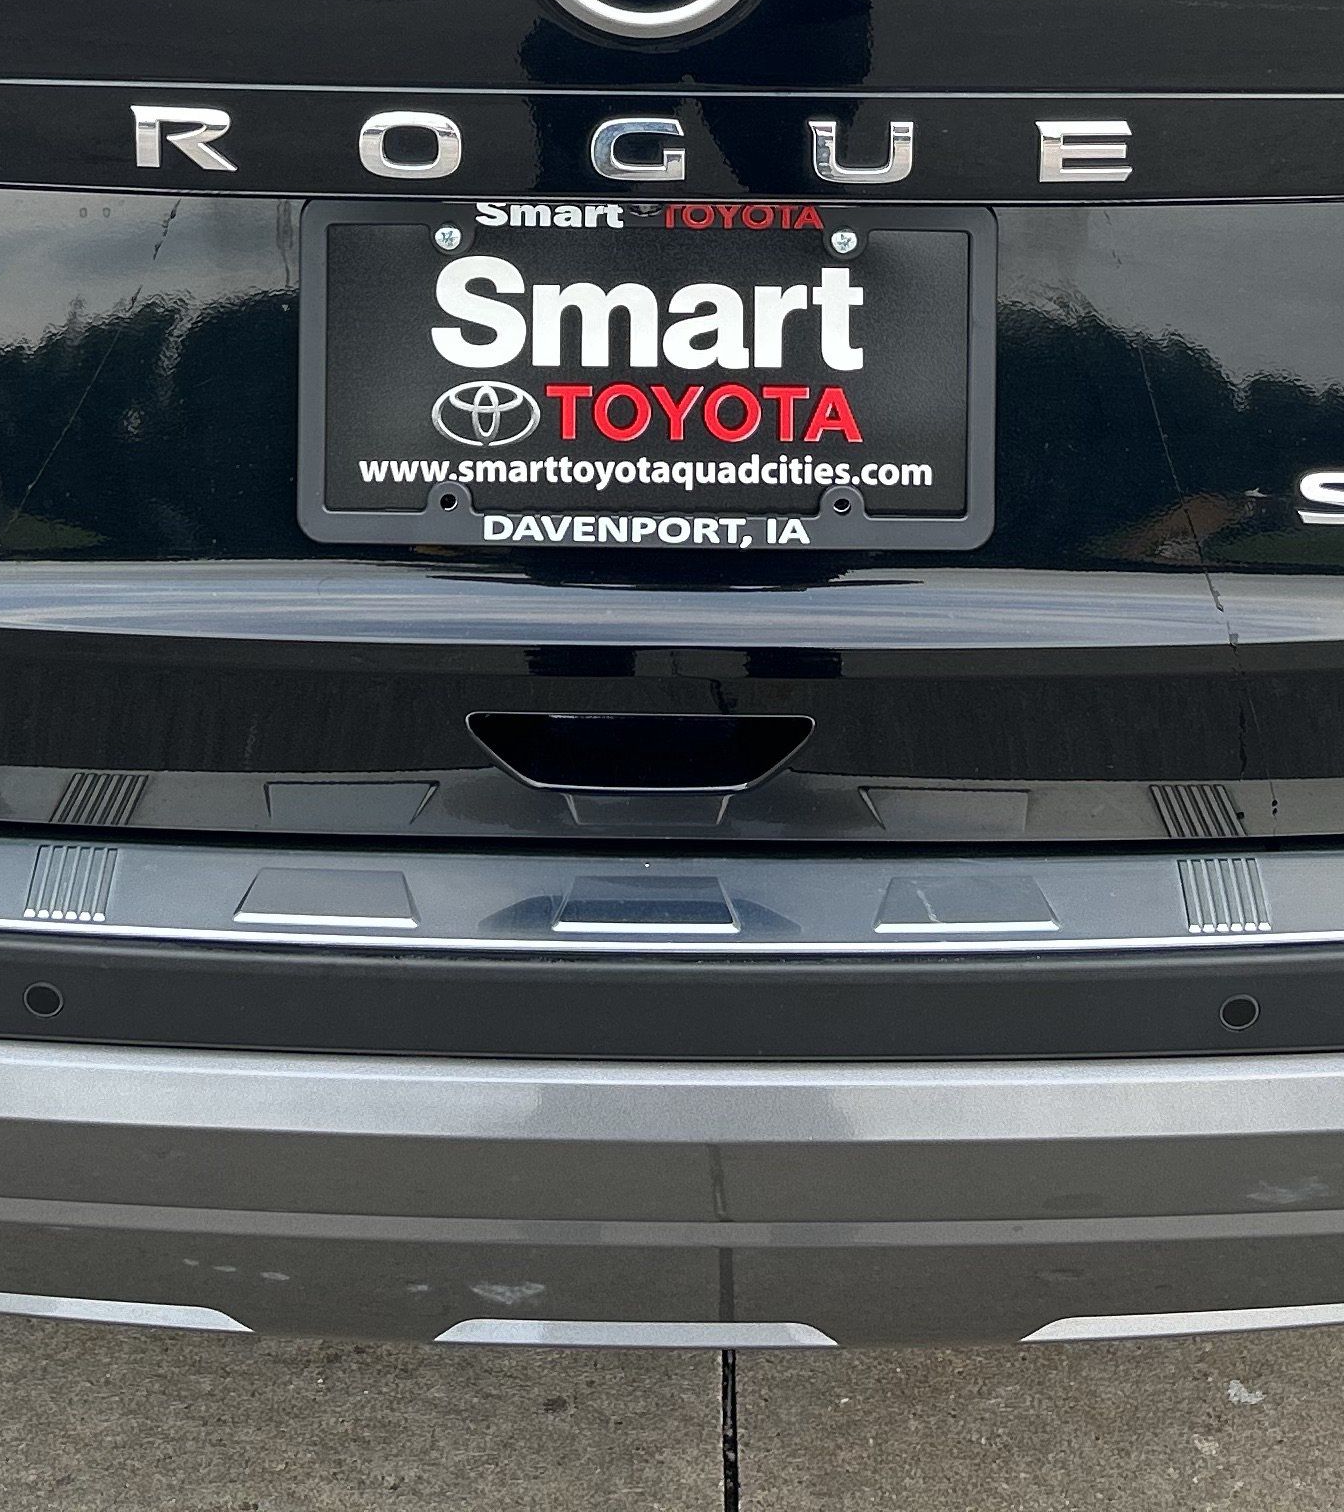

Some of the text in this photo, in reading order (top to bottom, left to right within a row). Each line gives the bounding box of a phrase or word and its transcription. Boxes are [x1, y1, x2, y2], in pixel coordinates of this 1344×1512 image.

[130, 104, 1134, 185] ROGUE
[475, 202, 824, 230] Smart TOYOTA
[431, 255, 864, 371] Smart
[546, 384, 863, 443] TOYOTA
[359, 455, 933, 490] www.smarttoyotaquadcities.com
[483, 516, 811, 548] DAVENPORT, IA
